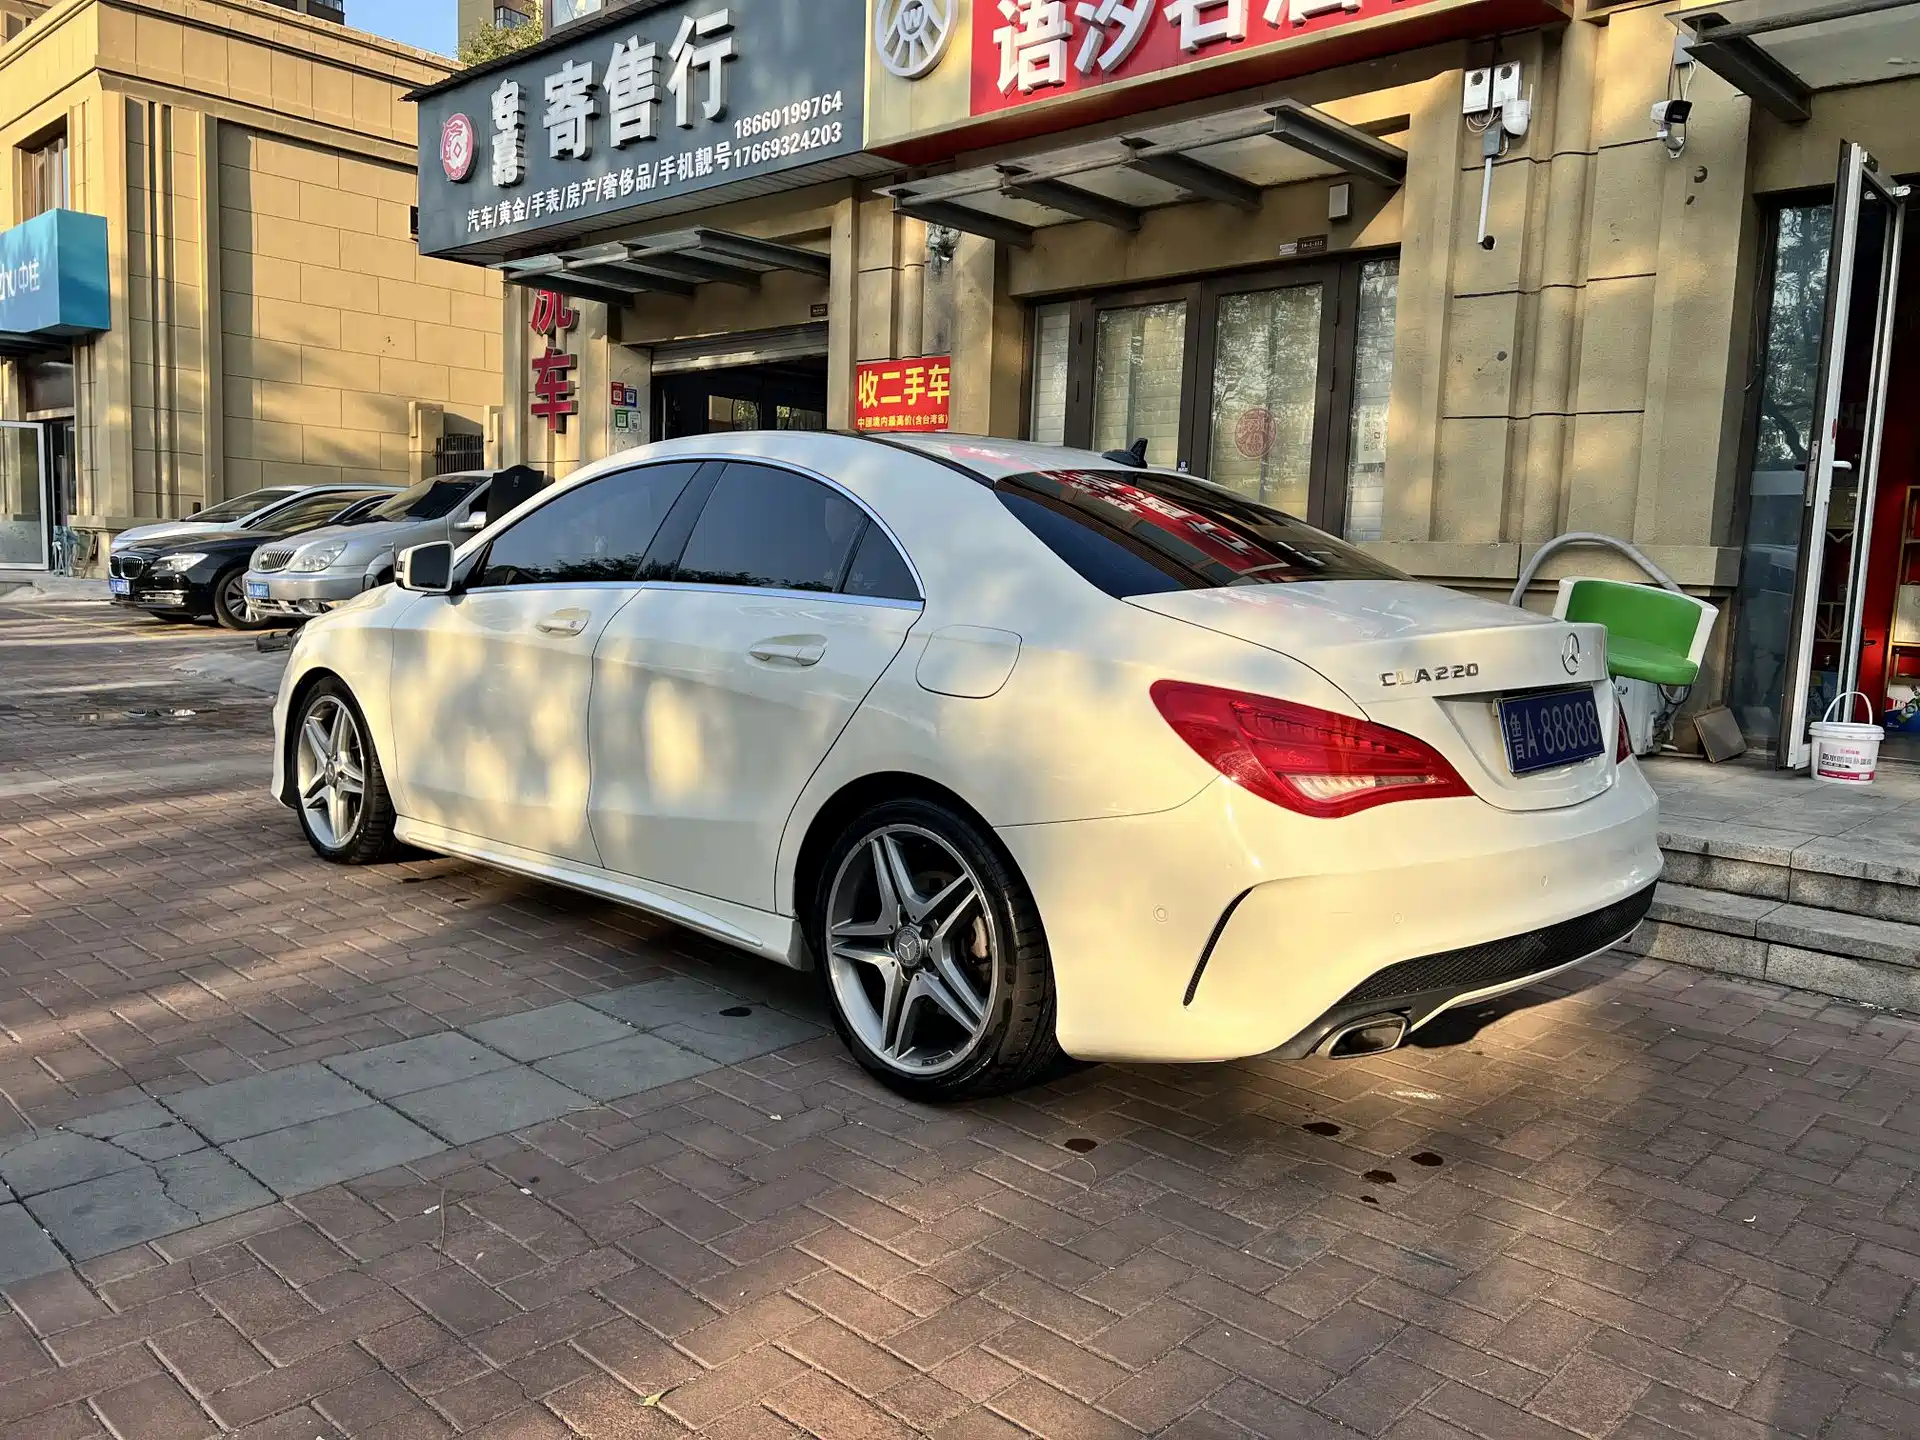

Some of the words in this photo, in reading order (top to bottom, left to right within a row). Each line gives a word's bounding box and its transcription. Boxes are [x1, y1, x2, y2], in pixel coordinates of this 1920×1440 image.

[543, 8, 737, 160] 寄售行
[733, 90, 844, 140] 18660199764
[733, 121, 843, 169] 17669324203
[466, 142, 734, 233] 汽车/黄金/手表/房产/奢侈品/手机靓号
[858, 364, 950, 409] 收二手车
